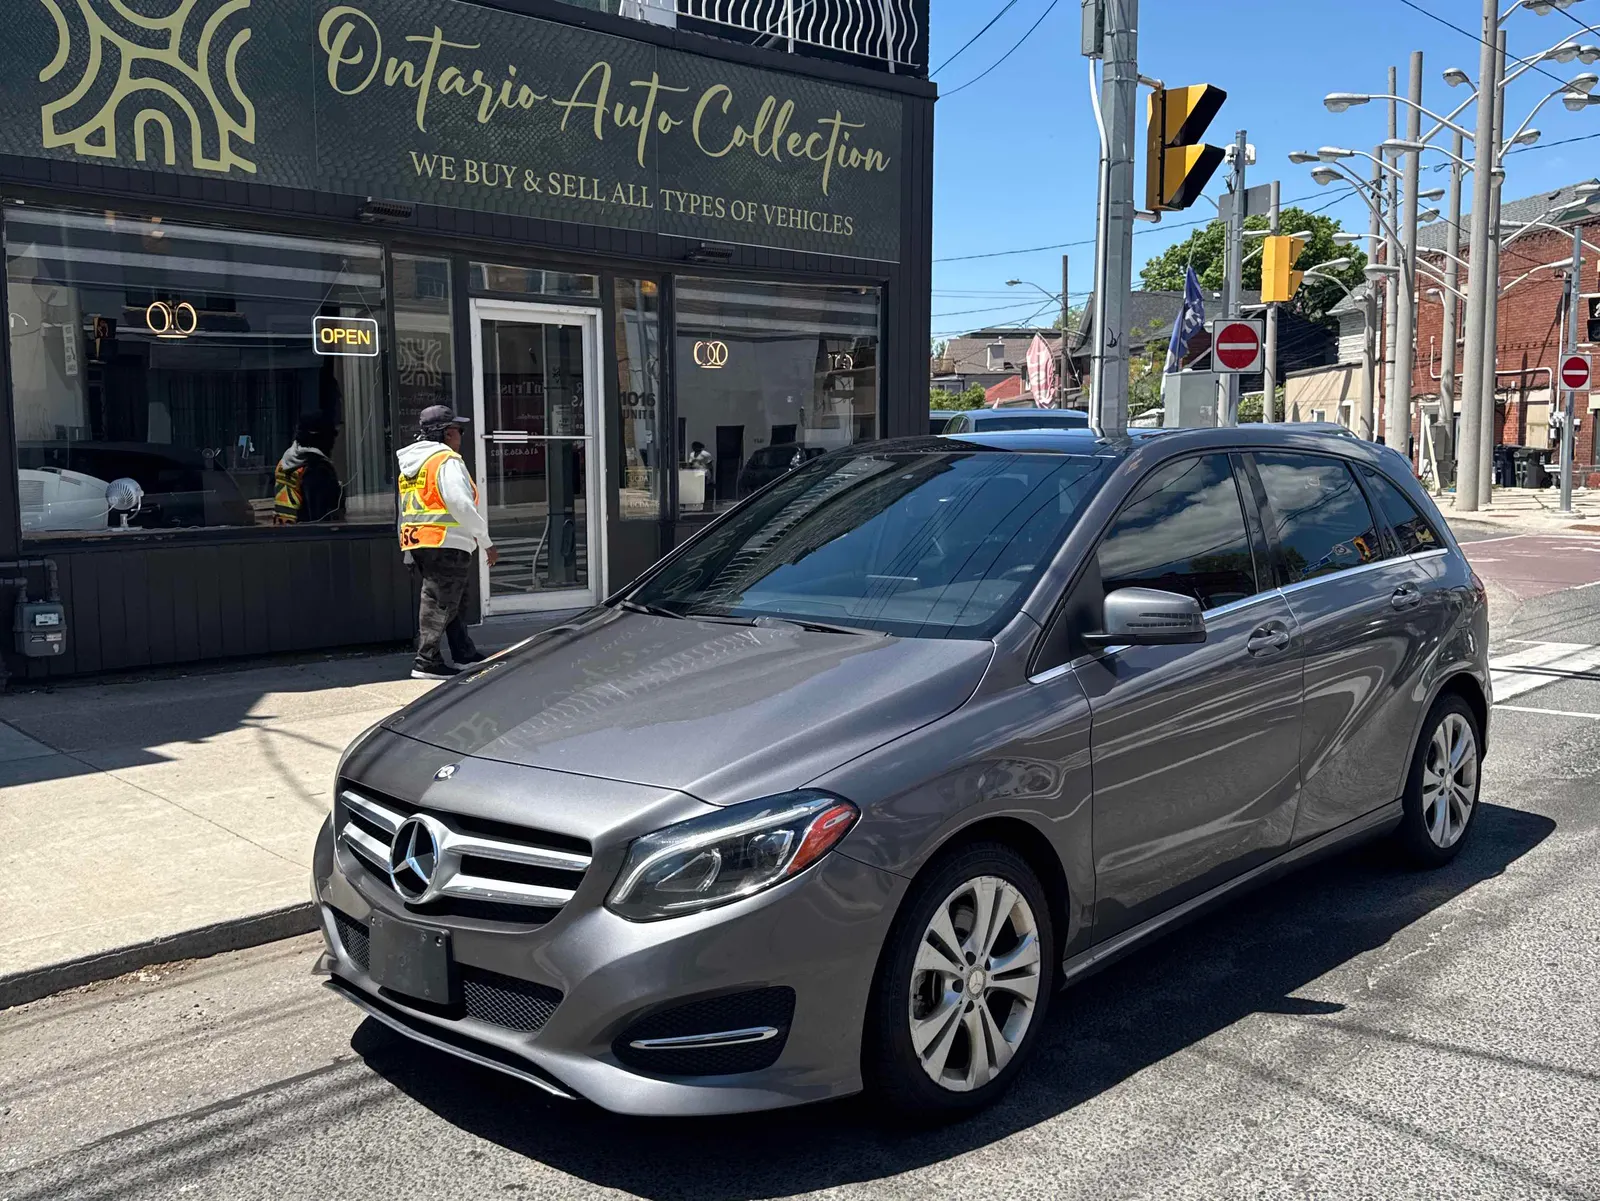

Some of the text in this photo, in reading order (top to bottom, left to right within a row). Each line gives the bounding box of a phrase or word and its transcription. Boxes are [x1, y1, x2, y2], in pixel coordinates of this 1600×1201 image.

[318, 5, 892, 196] Ontario Auto Collection
[409, 151, 854, 236] WE BUY & SELL ALL TYPES OF VEHICLES
[320, 327, 371, 345] OPEN
[620, 391, 656, 407] 1016
[621, 409, 647, 420] UNIT
